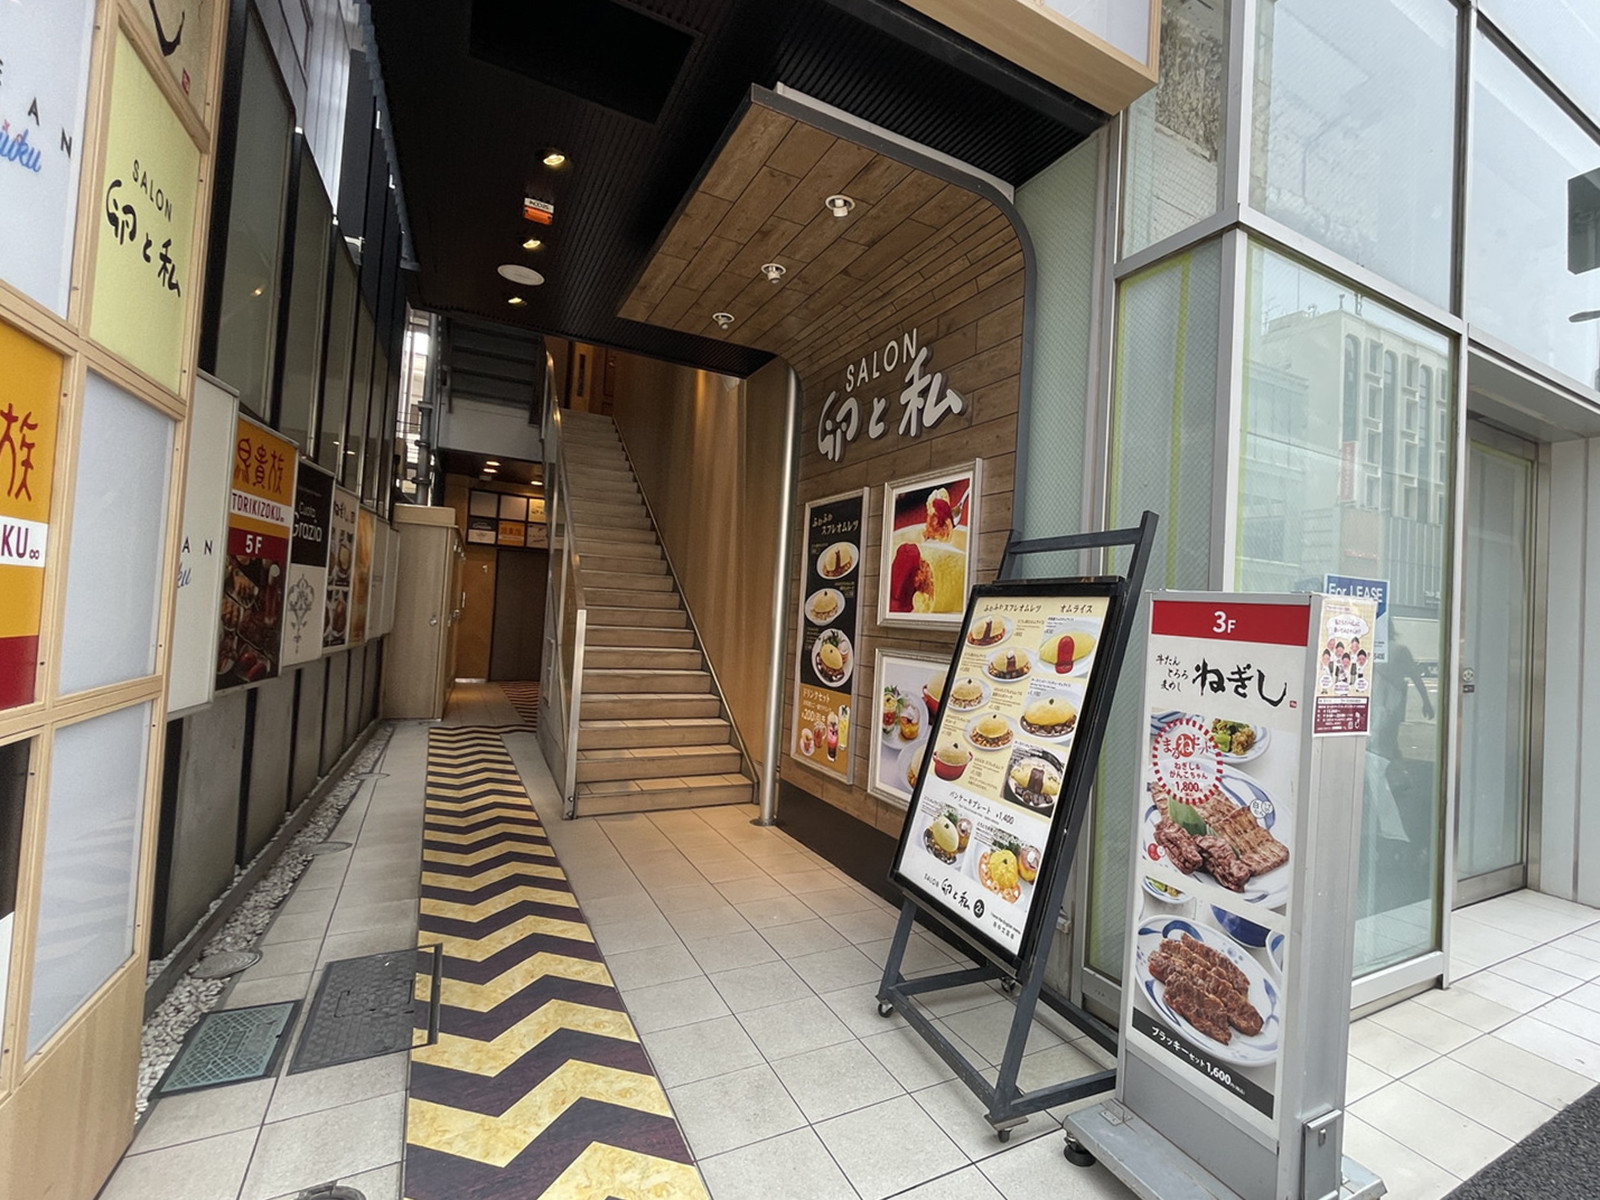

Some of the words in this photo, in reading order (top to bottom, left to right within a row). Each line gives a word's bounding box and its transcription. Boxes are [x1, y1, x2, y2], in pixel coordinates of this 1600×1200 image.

[132, 158, 173, 222] SALON
[845, 328, 917, 392] SALON
[817, 346, 964, 462] 卵と私
[245, 533, 262, 554] 5F
[1060, 604, 1093, 614] オムライス
[1212, 610, 1236, 634] 3F
[1192, 657, 1288, 708] ねぎし
